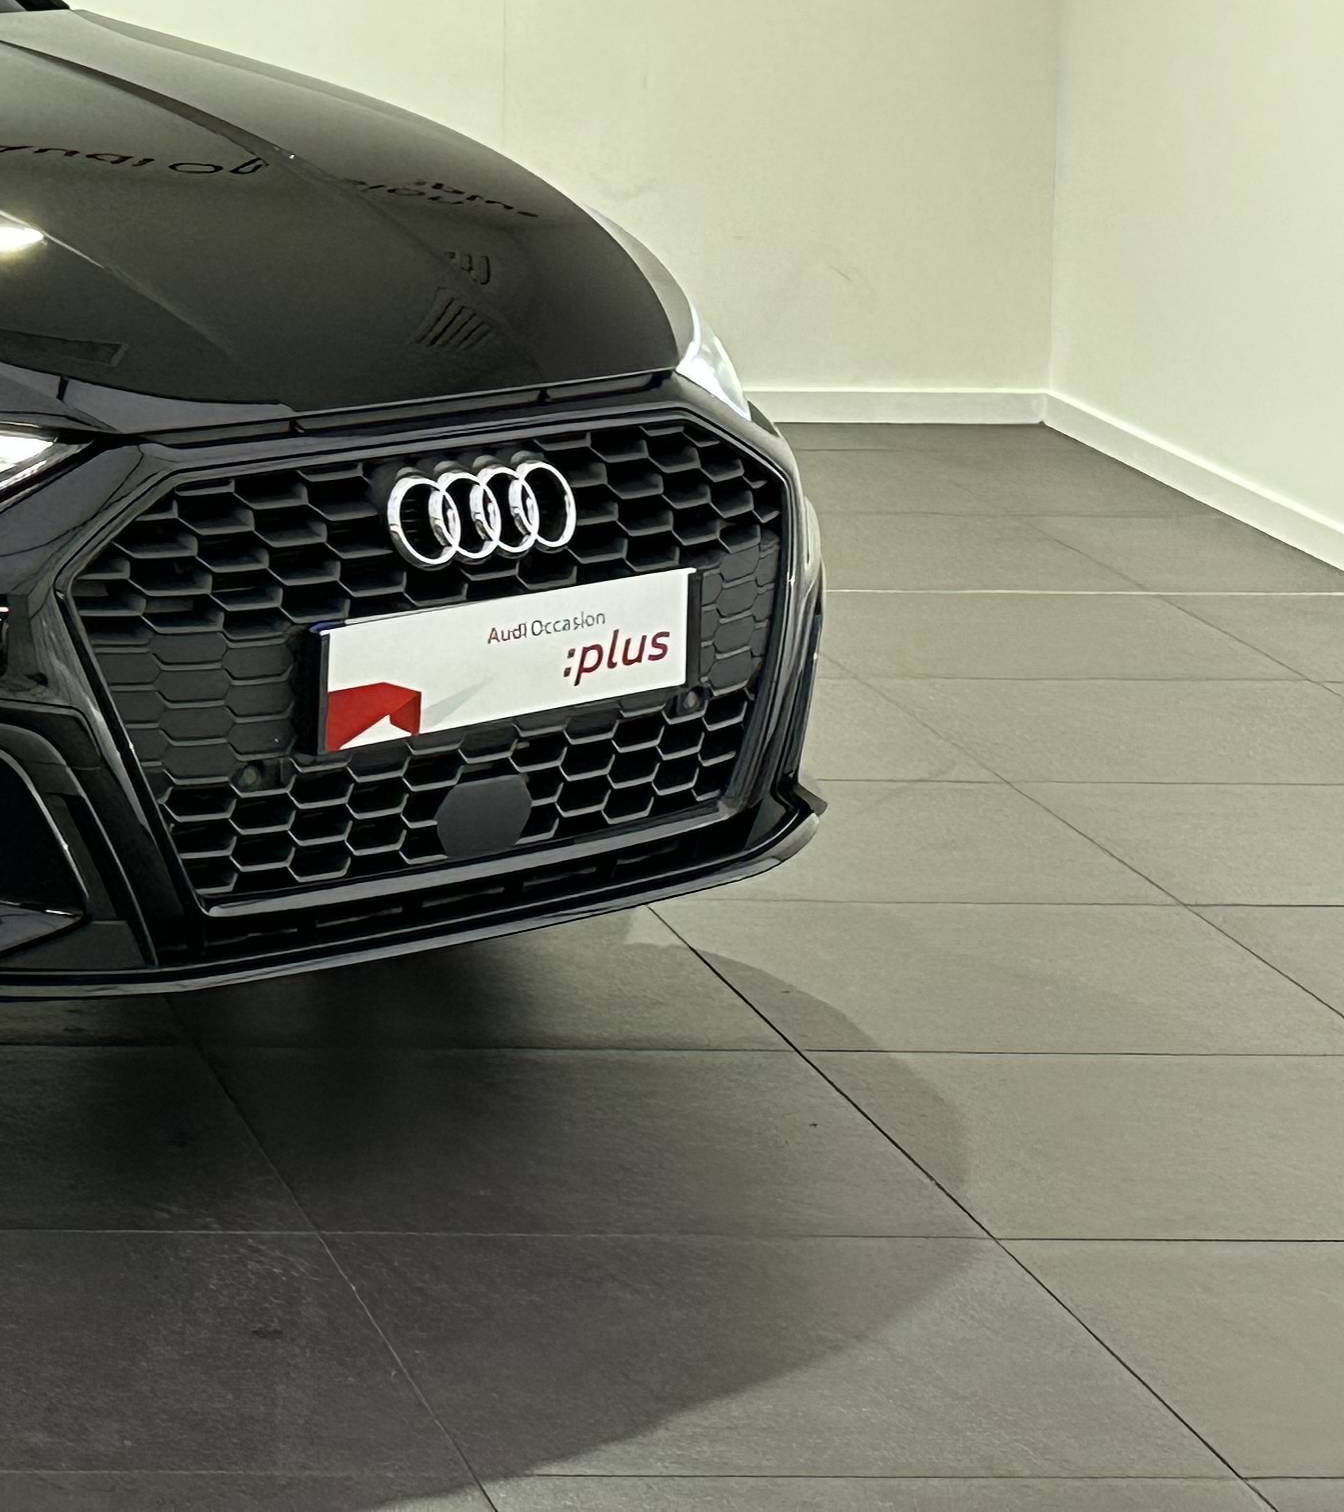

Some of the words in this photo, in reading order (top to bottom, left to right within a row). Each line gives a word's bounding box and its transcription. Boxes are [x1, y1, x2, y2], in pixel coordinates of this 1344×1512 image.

[487, 622, 527, 645] Audi
[530, 611, 606, 637] Occasion
[563, 629, 671, 687] :plus
